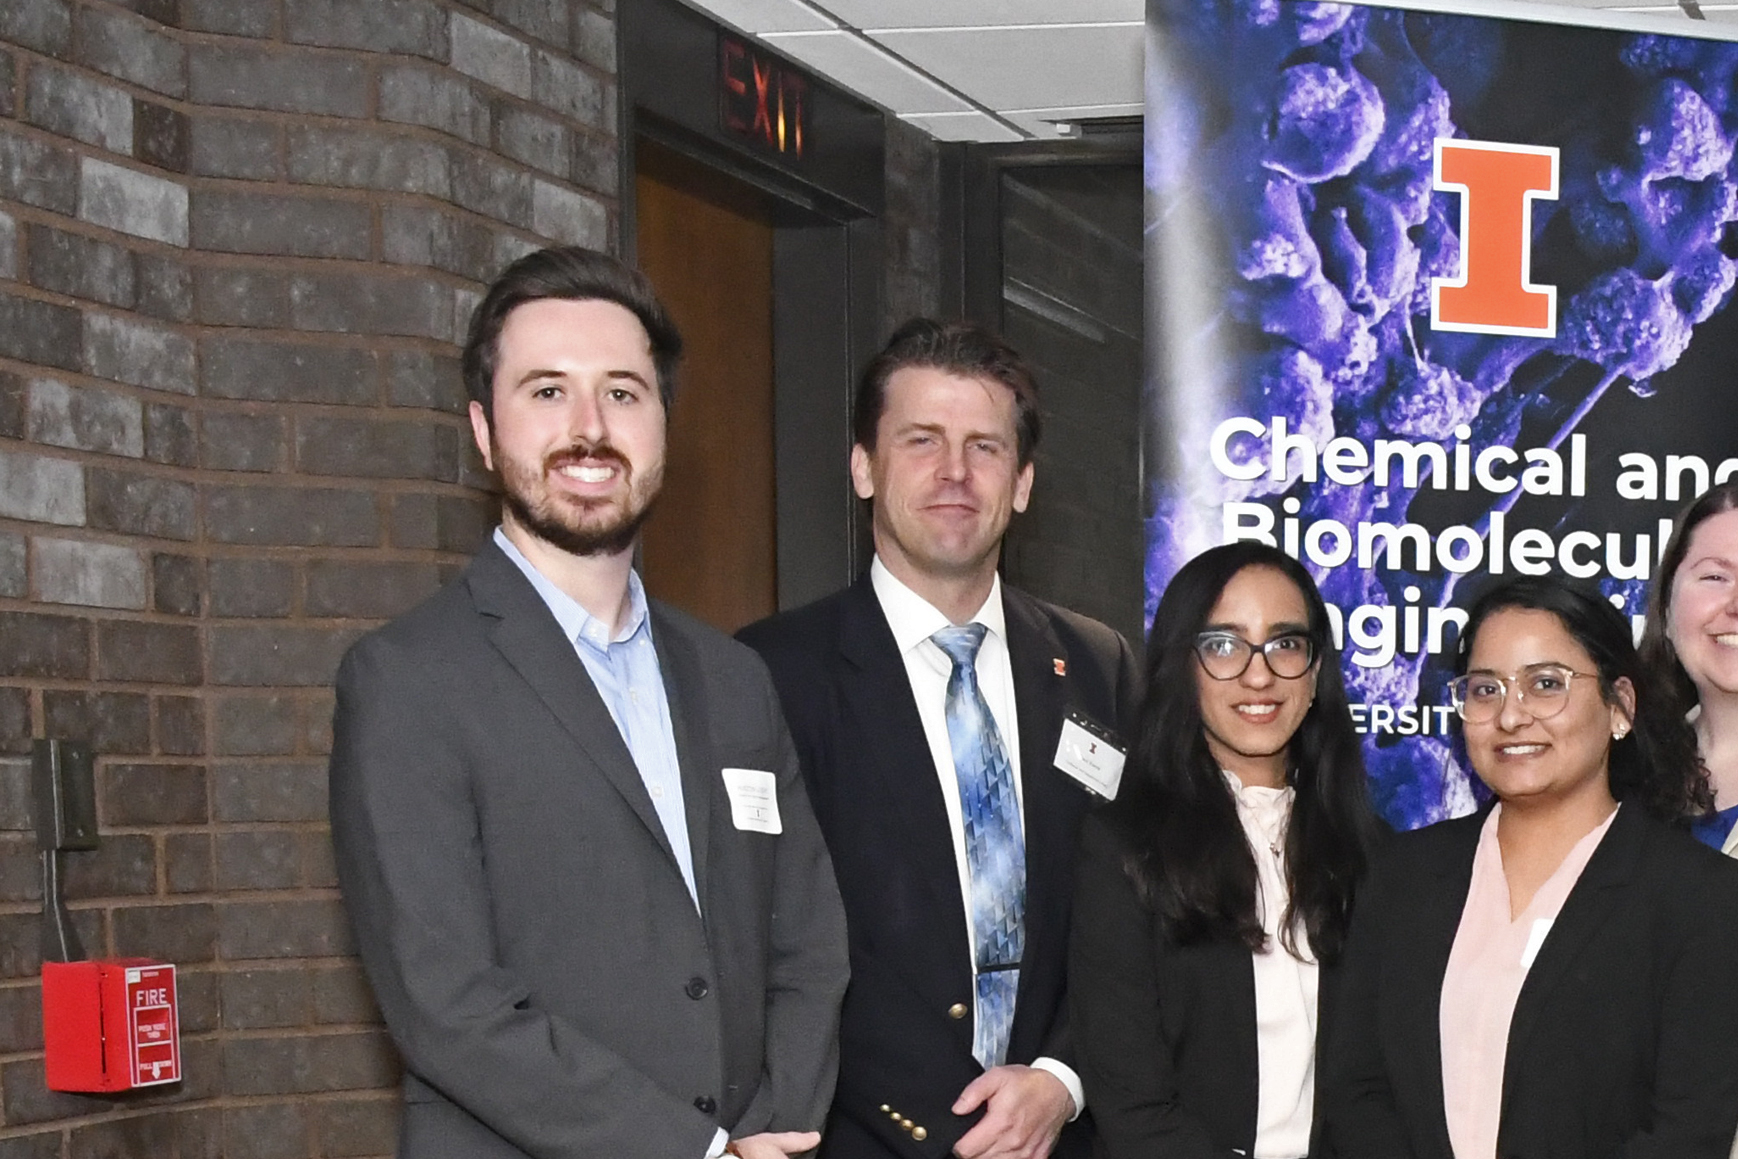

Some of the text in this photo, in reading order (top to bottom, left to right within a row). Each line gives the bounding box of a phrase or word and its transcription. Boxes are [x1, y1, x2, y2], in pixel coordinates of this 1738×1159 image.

[723, 39, 806, 158] EXIT
[1430, 137, 1560, 339] I
[1210, 416, 1586, 496] Chemical
[136, 988, 167, 1006] FIRE
